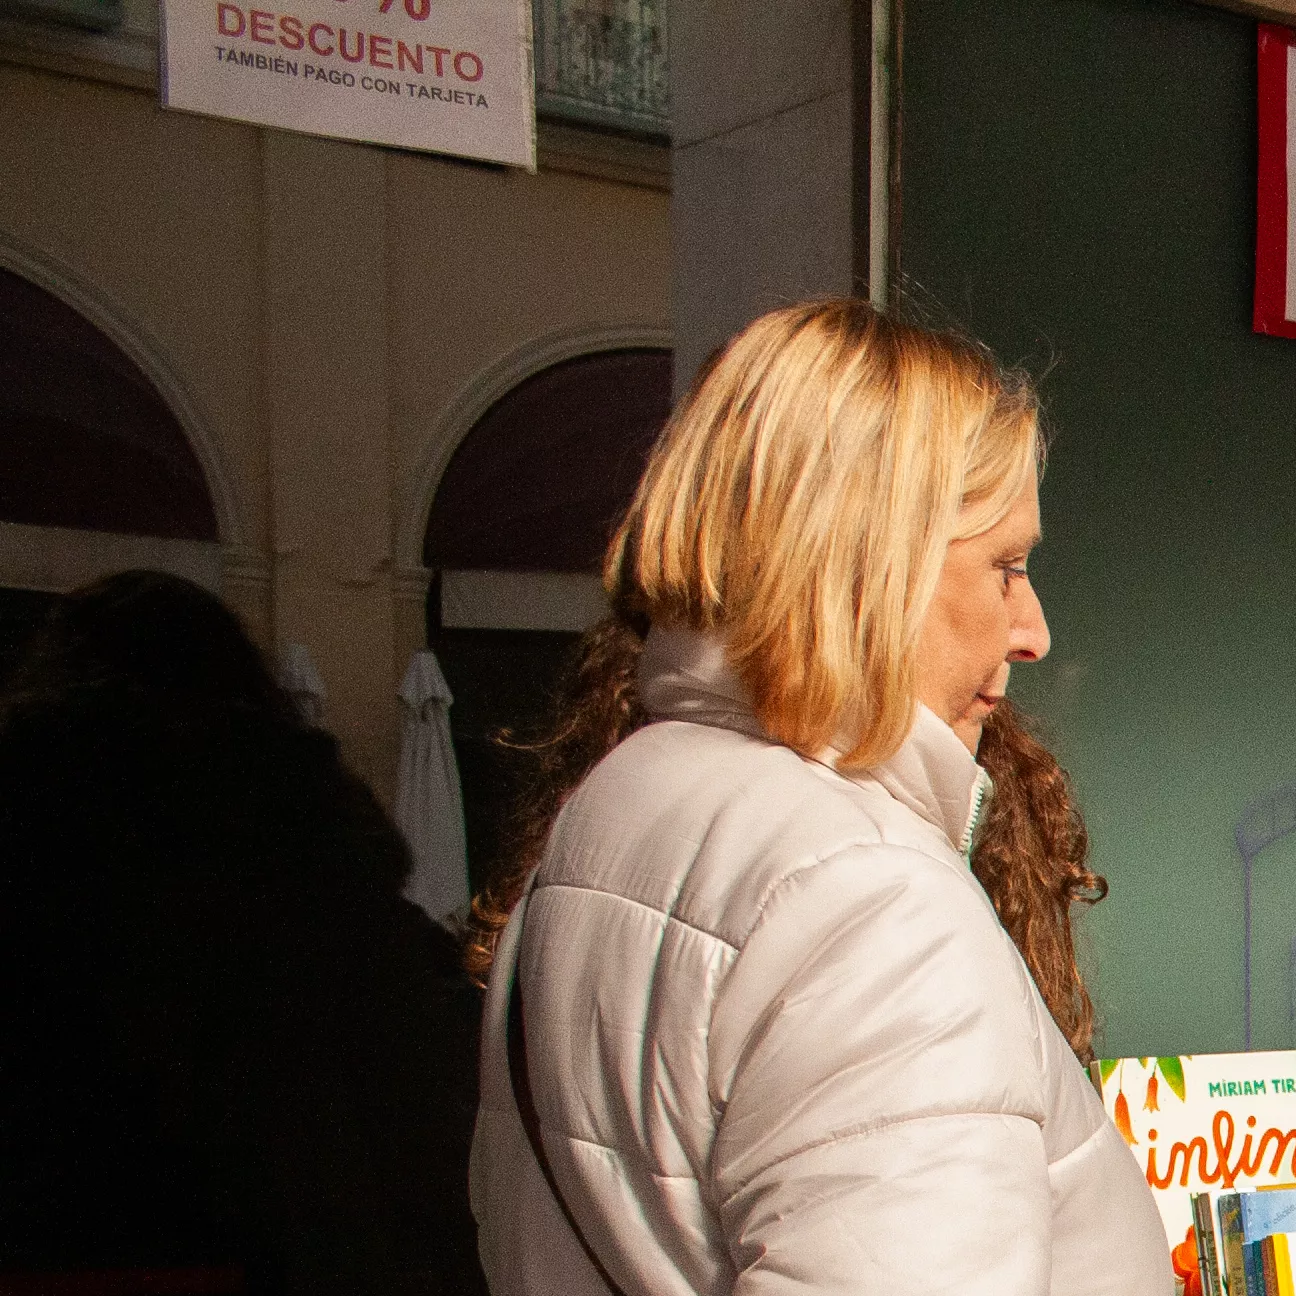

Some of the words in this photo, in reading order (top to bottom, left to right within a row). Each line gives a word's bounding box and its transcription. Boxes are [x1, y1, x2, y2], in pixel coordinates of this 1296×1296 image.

[217, 2, 483, 82] DESCUENTO
[214, 46, 298, 77] TAMBIÉN
[304, 64, 355, 88] PAGO
[361, 76, 401, 95] CON
[406, 83, 490, 109] TARJETA
[1209, 1078, 1267, 1098] MÍRIAM
